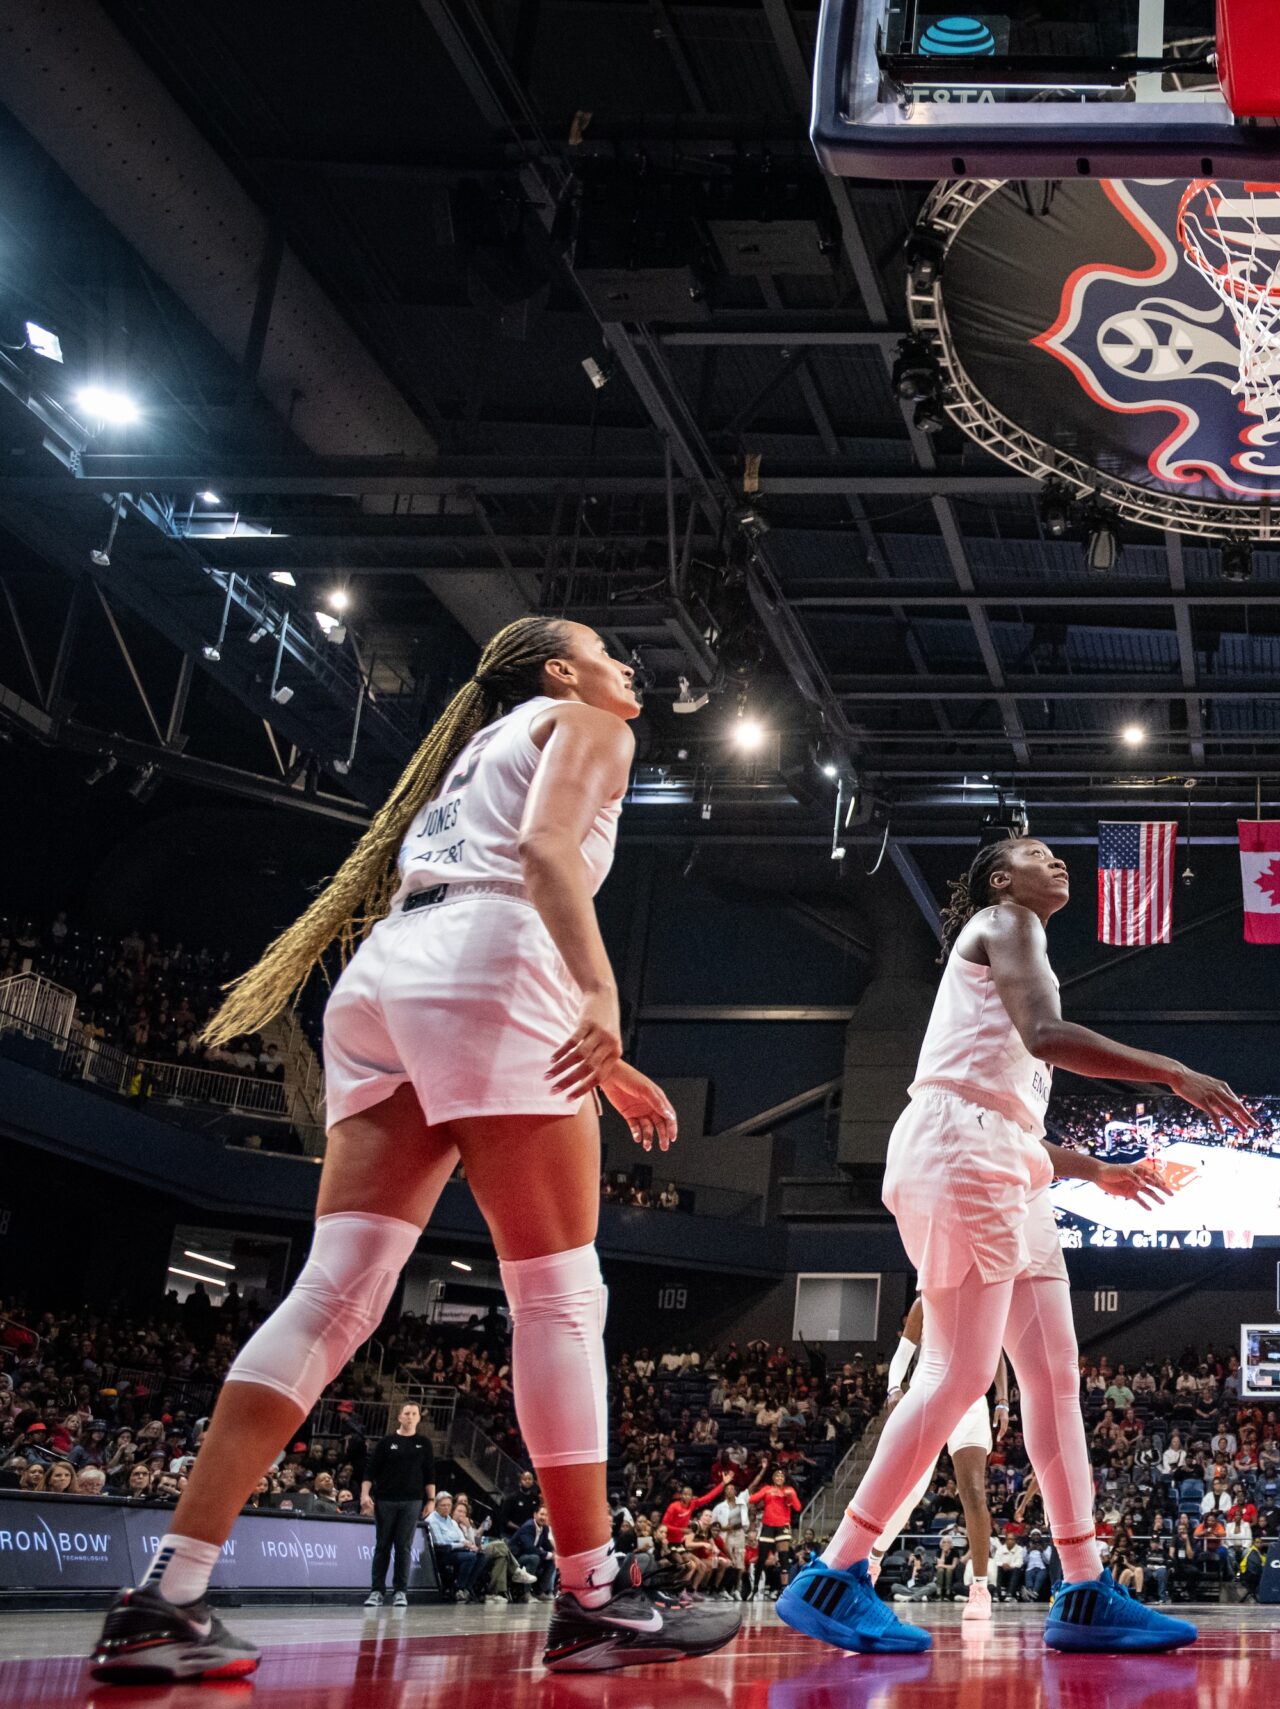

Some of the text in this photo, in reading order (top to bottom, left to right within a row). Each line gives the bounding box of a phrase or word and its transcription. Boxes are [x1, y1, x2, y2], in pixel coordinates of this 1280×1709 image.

[417, 799, 461, 838] JONES
[411, 839, 466, 865] AT&T
[1032, 1071, 1050, 1103] EMO
[1132, 1232, 1168, 1248] 6:11
[1184, 1230, 1212, 1247] 40
[658, 1289, 687, 1309] 109
[1094, 1291, 1118, 1312] 110
[0, 1531, 108, 1553] RON BOW
[143, 1536, 159, 1554] IR
[262, 1541, 337, 1559] IRON BOW
[62, 1554, 109, 1562] TECHNOLOGIES
[357, 1545, 375, 1560] IR
